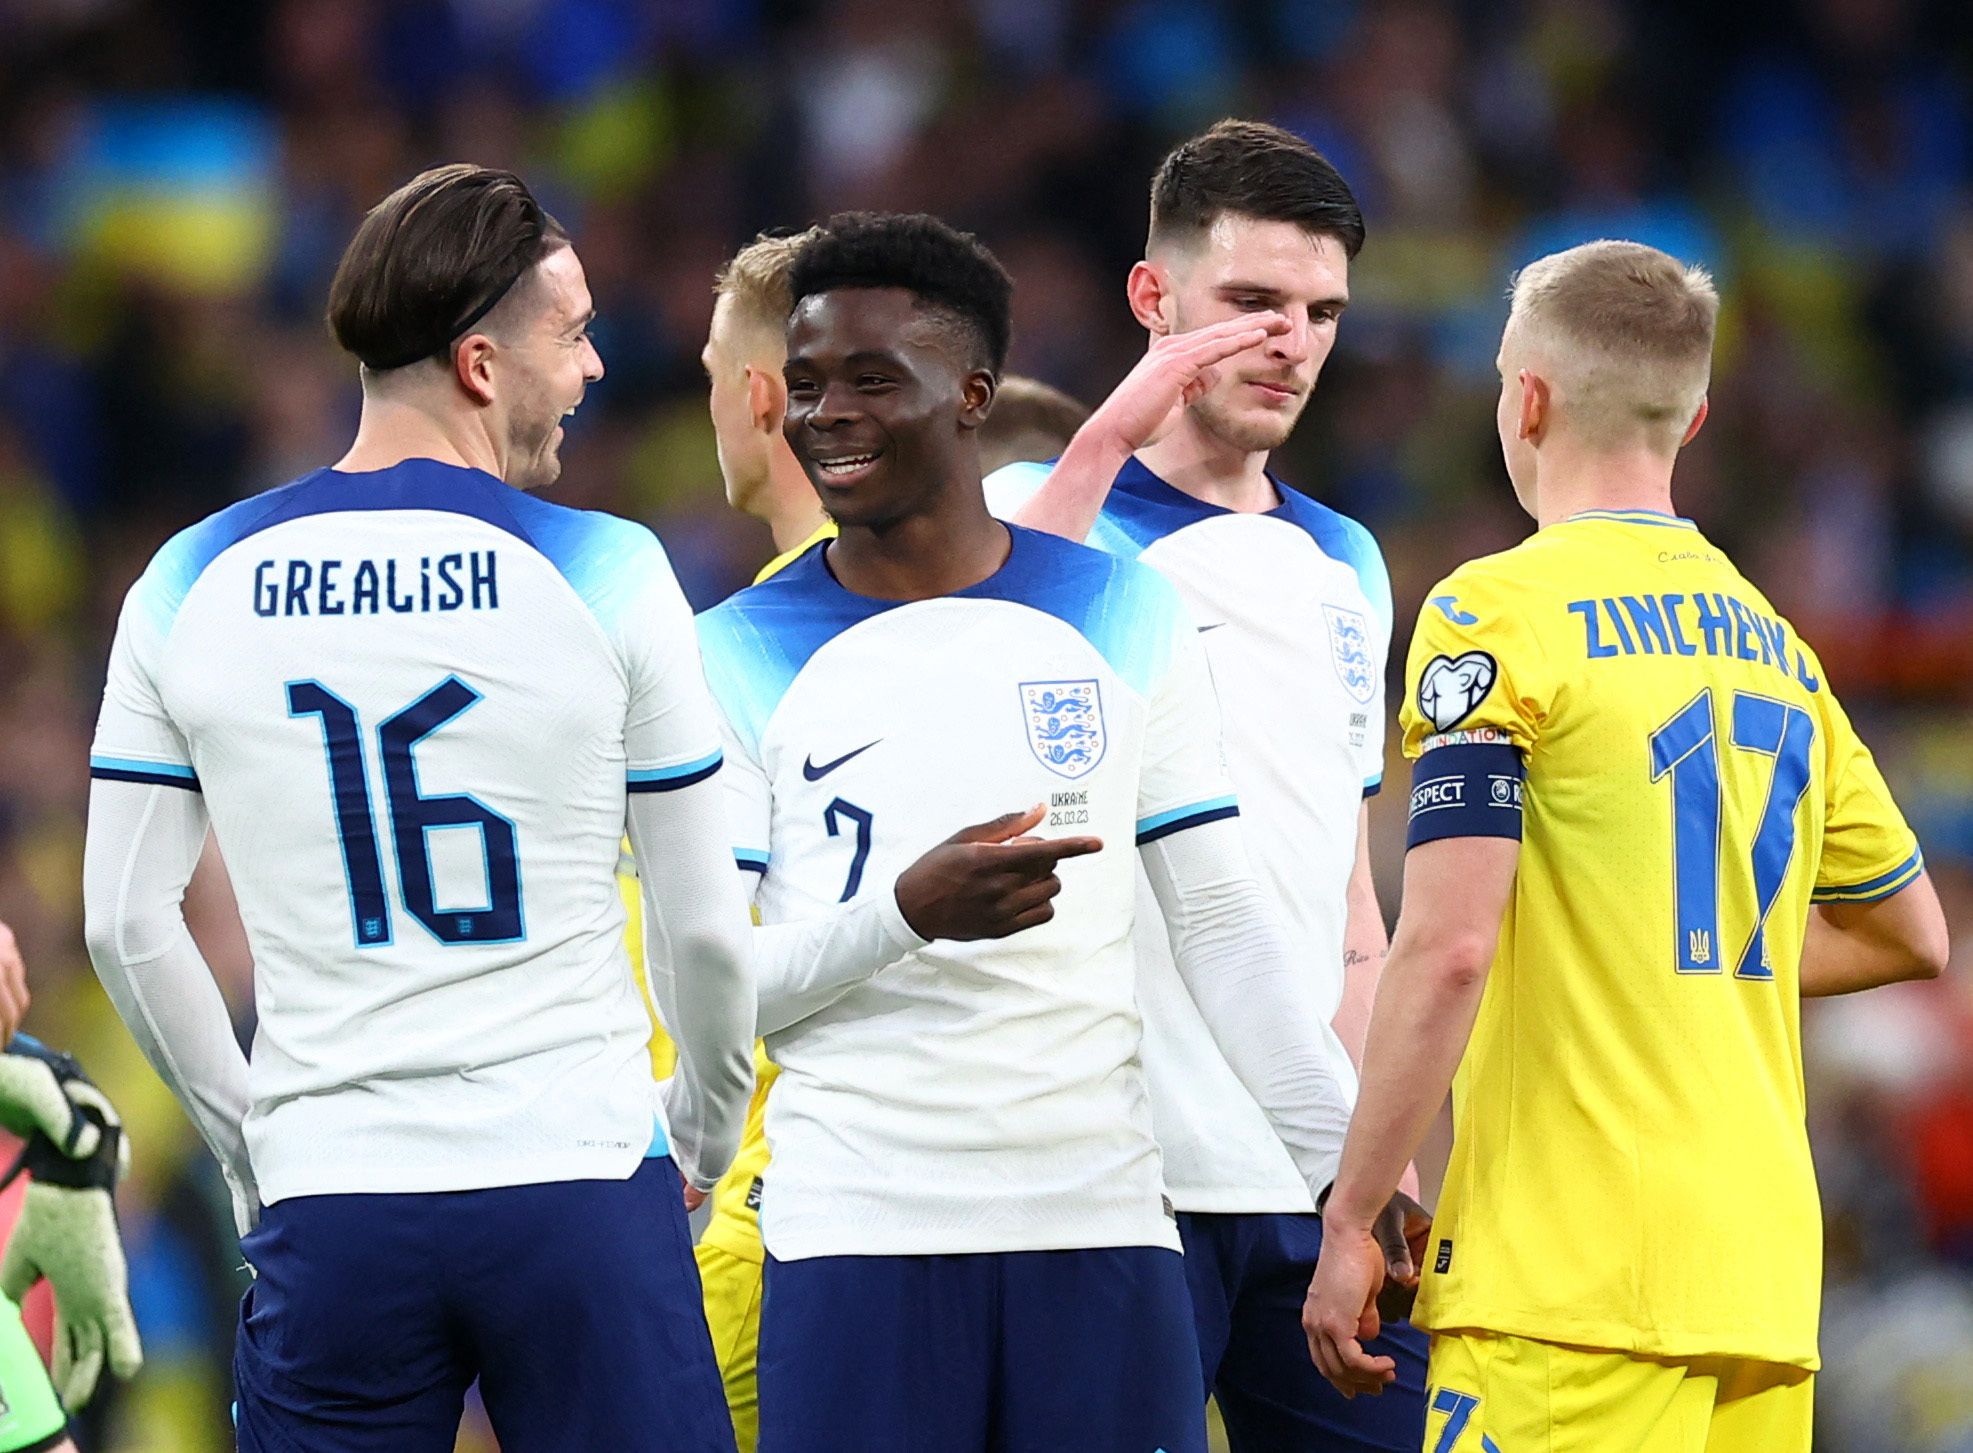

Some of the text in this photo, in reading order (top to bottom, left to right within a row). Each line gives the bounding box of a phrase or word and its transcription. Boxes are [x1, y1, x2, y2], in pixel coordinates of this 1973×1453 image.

[284, 673, 527, 949] 16
[824, 796, 874, 904] 7
[1050, 809, 1089, 826] 26.03.23
[1648, 687, 1816, 981] 17
